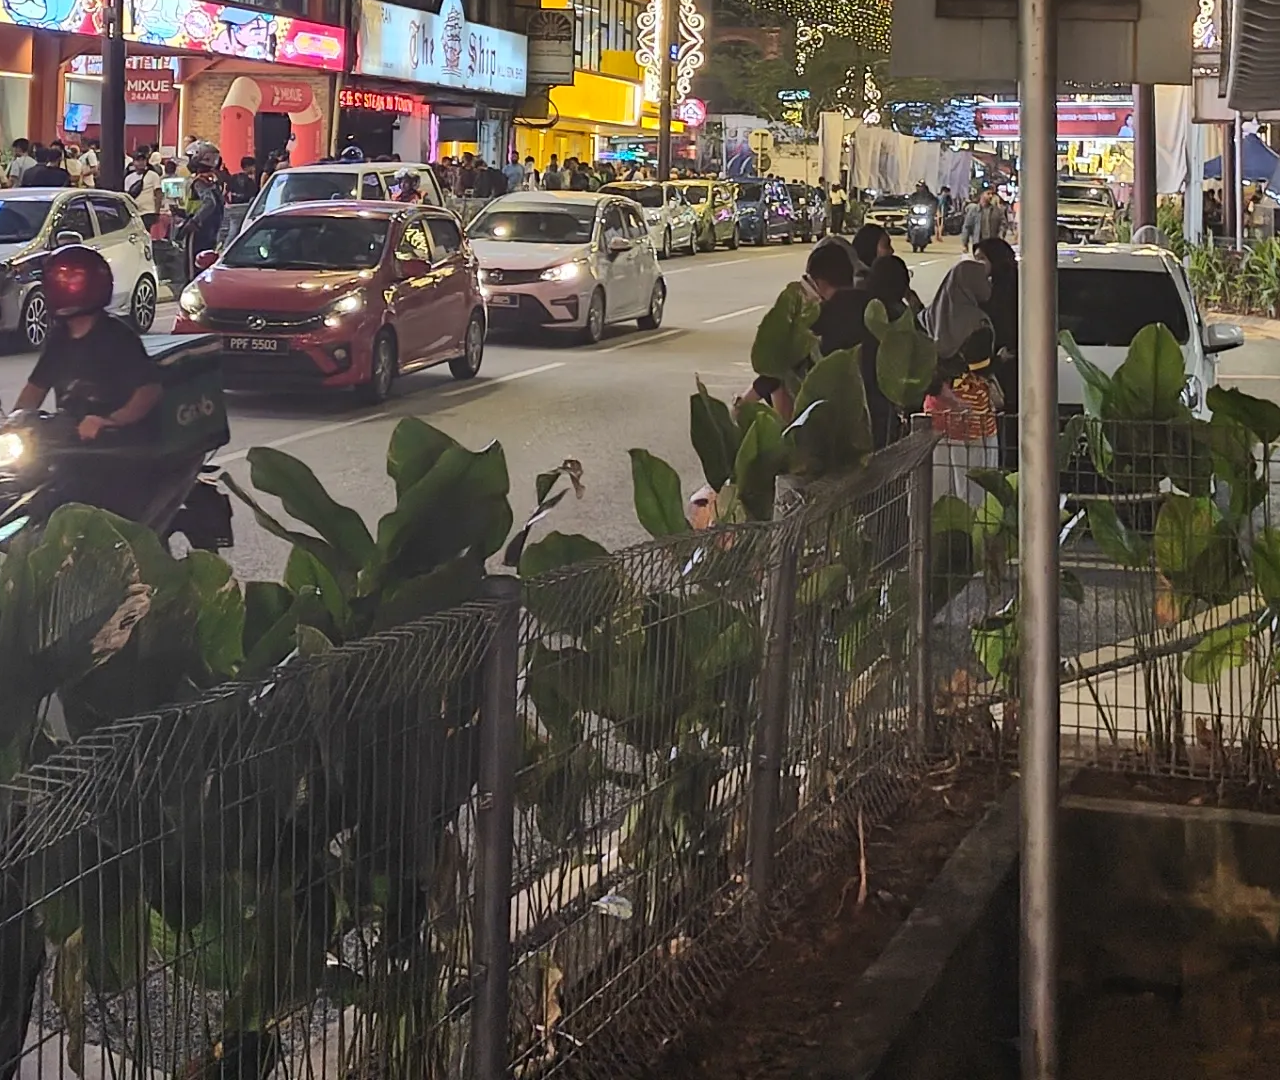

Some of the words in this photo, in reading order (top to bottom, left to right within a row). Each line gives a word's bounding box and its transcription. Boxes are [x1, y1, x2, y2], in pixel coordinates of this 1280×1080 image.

[408, 19, 435, 70] The
[466, 31, 497, 86] Ship
[126, 79, 170, 92] MIXUE
[280, 86, 304, 102] MIXUE
[230, 337, 250, 351] PPF
[251, 338, 278, 351] 5503
[176, 394, 215, 426] Grab
